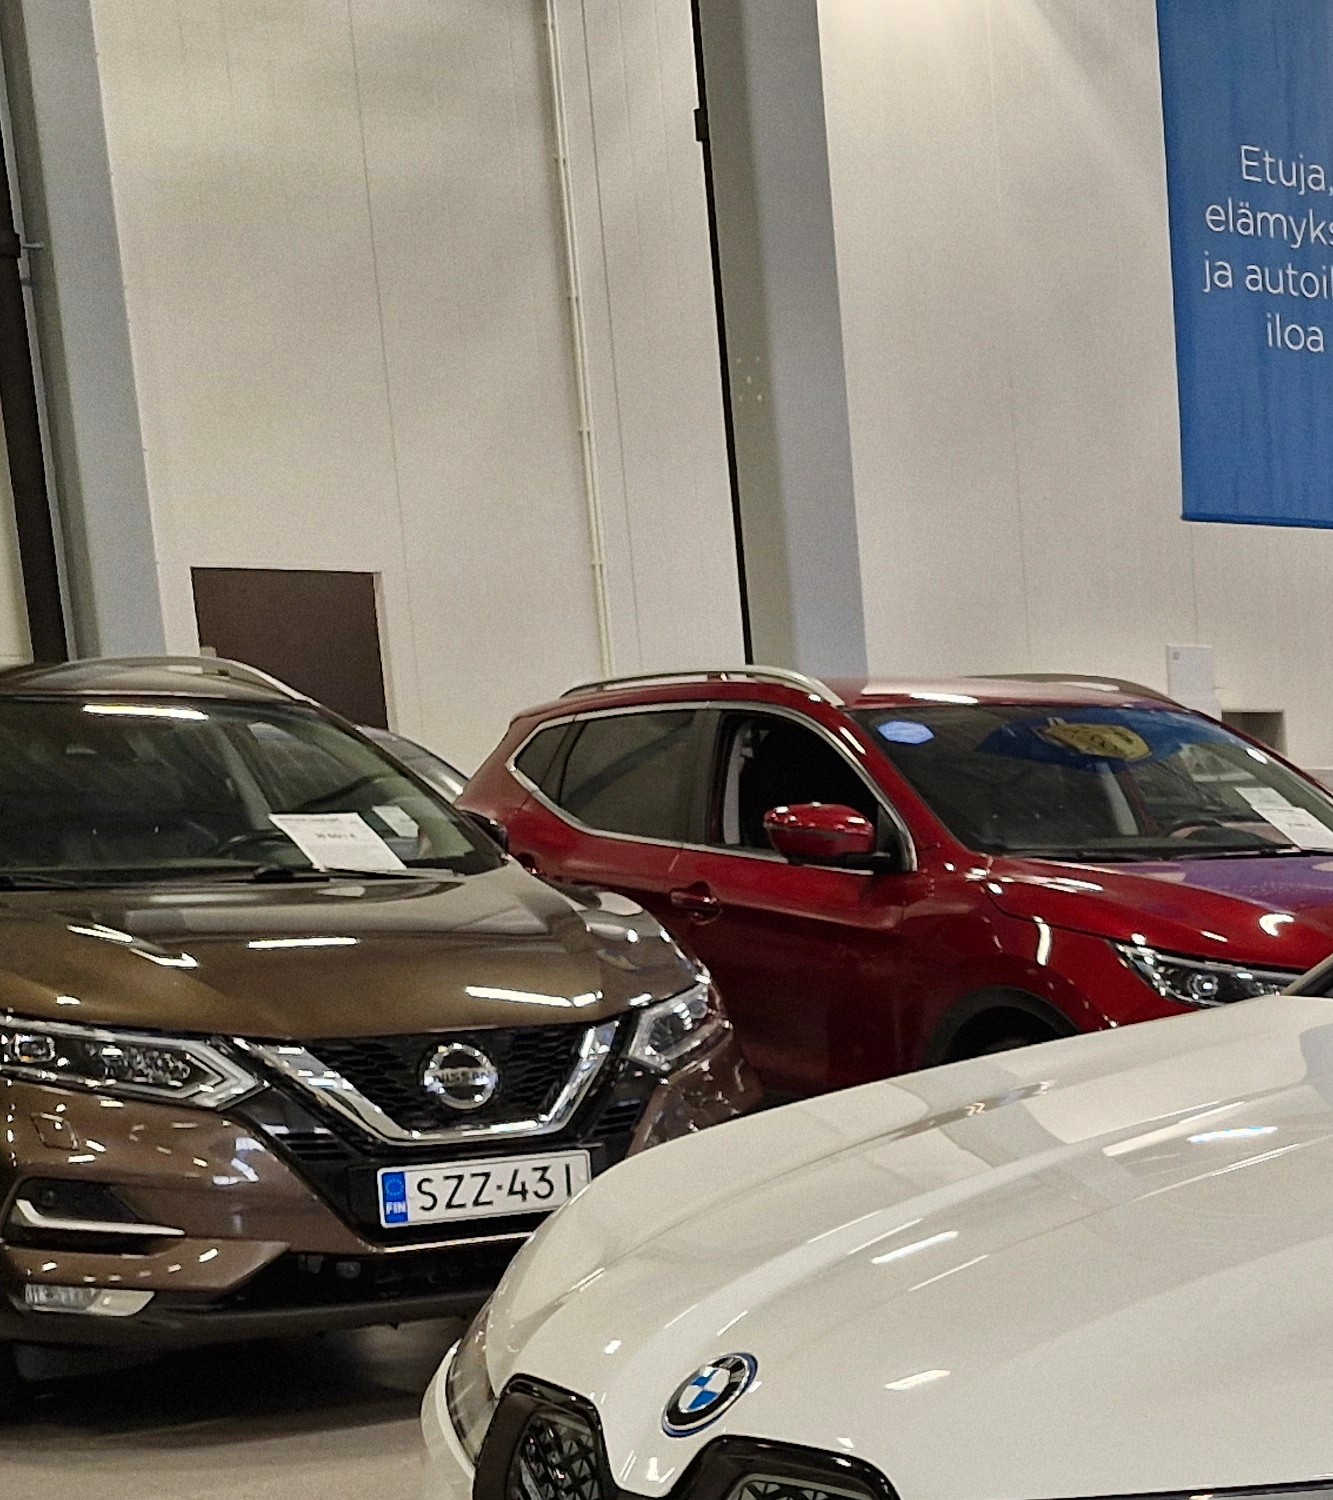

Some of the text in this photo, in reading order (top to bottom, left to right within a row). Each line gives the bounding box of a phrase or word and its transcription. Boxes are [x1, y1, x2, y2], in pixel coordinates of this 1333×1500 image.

[1202, 250, 1234, 294] ja
[1266, 312, 1325, 353] iloa
[416, 1162, 573, 1212] SZZ-431
[384, 1200, 408, 1217] FIN
